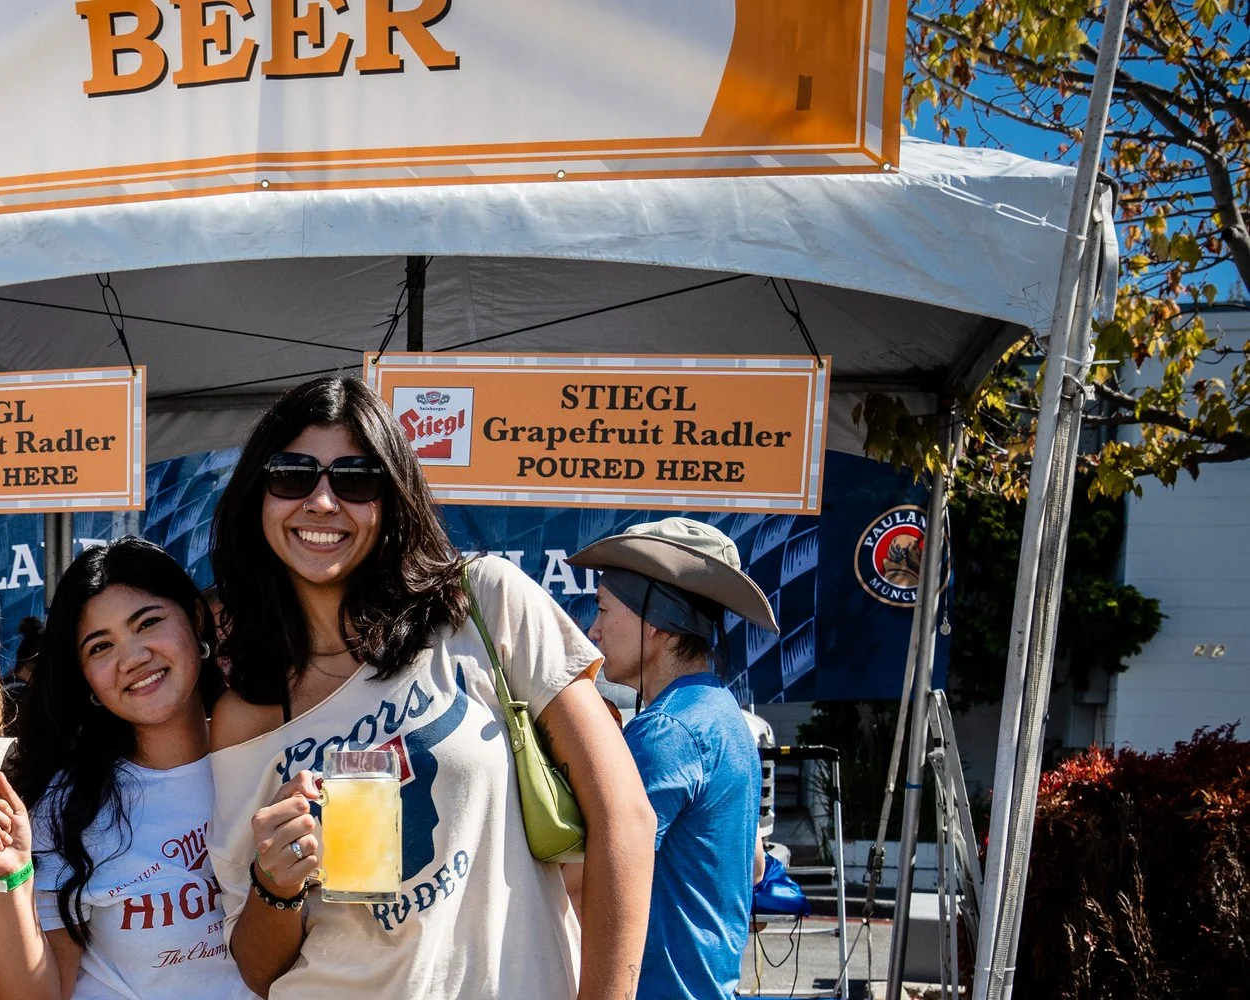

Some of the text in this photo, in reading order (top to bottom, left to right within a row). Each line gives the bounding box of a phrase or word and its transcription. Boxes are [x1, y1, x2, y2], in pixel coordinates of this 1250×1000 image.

[75, 0, 460, 98] BEER
[560, 384, 697, 412] STIEGL
[400, 408, 466, 442] Stiegl
[482, 417, 792, 451] Grapefruit Radler
[15, 429, 116, 455] Radler
[2, 465, 78, 488] HERE
[516, 456, 746, 483] POURED HERE
[864, 510, 926, 547] PAULAN
[372, 850, 470, 931] RODEO
[152, 949, 186, 969] The
